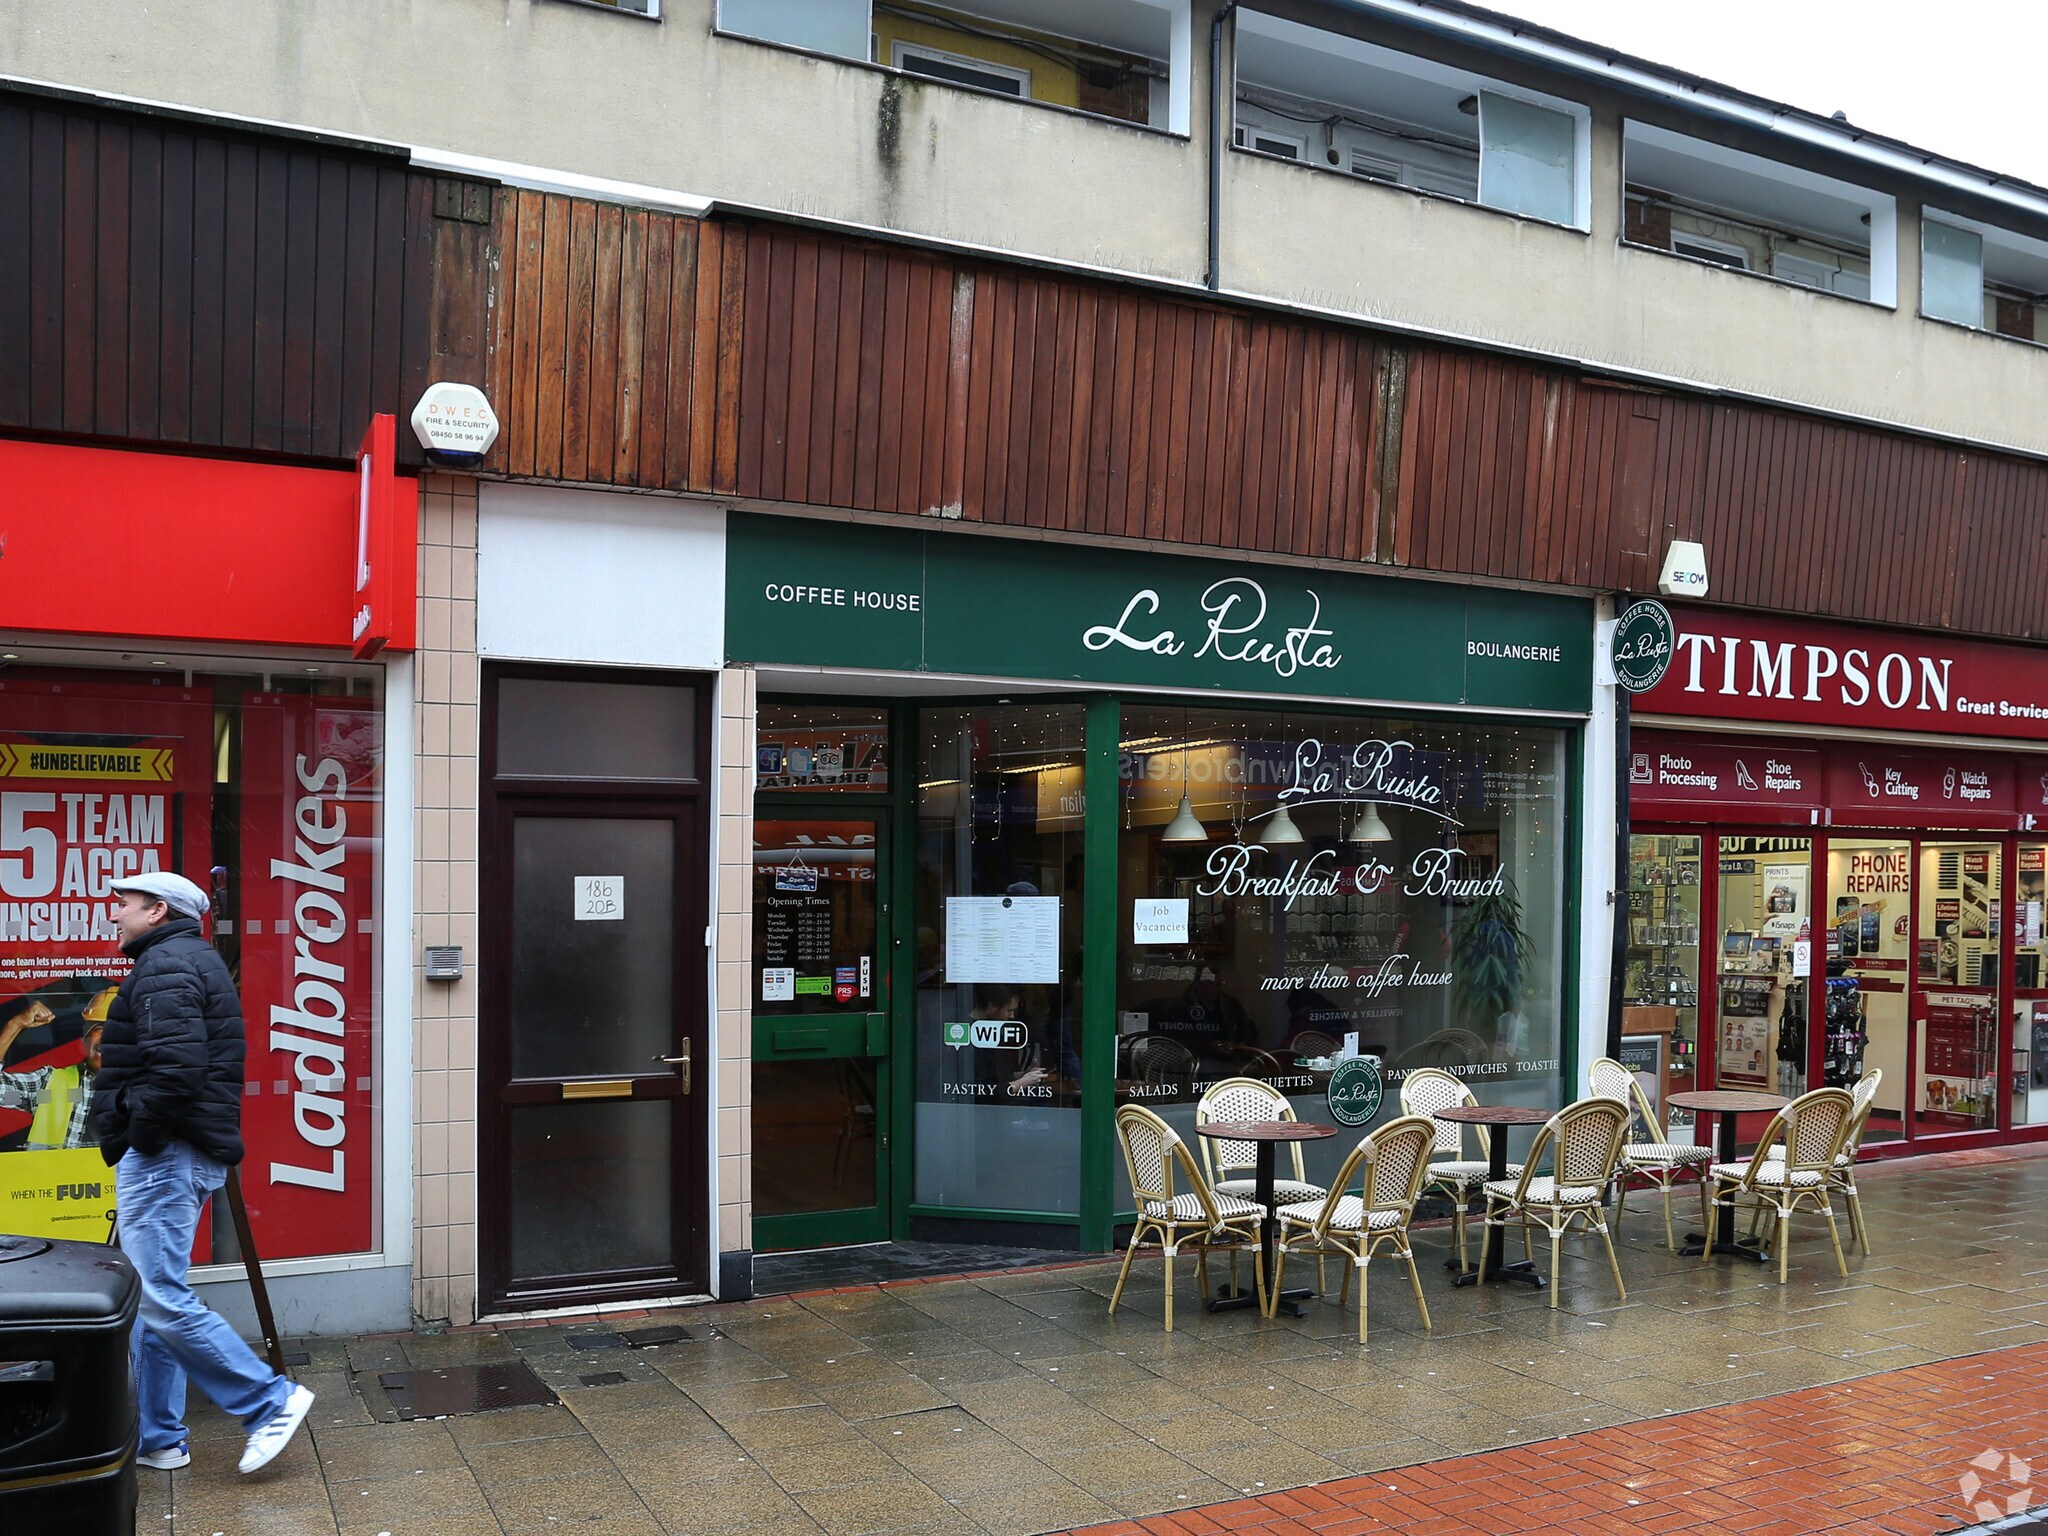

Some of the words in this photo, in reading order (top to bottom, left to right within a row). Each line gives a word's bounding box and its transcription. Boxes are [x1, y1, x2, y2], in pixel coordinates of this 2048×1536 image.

[425, 417, 443, 425] FIRE
[452, 420, 490, 429] SECURITY
[430, 430, 453, 438] 08450
[1672, 571, 1704, 585] SECOM
[765, 583, 845, 606] COFFEE
[853, 590, 920, 612] HOUSE
[1082, 588, 1185, 656] La
[1193, 576, 1342, 677] Rusta
[1618, 605, 1642, 636] COFFEE
[1644, 604, 1667, 629] HOUSE
[1467, 640, 1561, 662] BOULANGERIÉ
[1614, 642, 1636, 661] La
[1636, 633, 1669, 658] Rusta
[1618, 663, 1664, 688] BOULANGERIE
[1676, 632, 1953, 712] TIMPSON
[1956, 697, 1995, 716] Great
[30, 751, 142, 774] #UNBELIEVABLE
[1277, 738, 1333, 799] La
[1345, 739, 1443, 804] Rusta
[1659, 753, 1692, 771] Photo
[1765, 759, 1792, 774] Shoe
[1659, 770, 1718, 791] Processing
[1765, 775, 1801, 793] Repairs
[1885, 768, 1902, 784] Key
[1961, 772, 1988, 786] Watch
[1885, 782, 1919, 800] Cutting
[1960, 786, 1992, 802] Repairs
[1, 791, 57, 898] 5
[61, 793, 165, 844] TEAM
[1852, 854, 1906, 873] PHONE
[1196, 844, 1341, 912] Breakfast
[1355, 857, 1394, 894] &
[1403, 847, 1506, 897] Brunch
[1847, 874, 1909, 893] REPAIRS
[586, 900, 617, 915] 20B
[767, 897, 803, 907] Opening
[805, 897, 830, 905] Times
[1152, 906, 1170, 917] Job
[1136, 922, 1186, 932] Vacancies
[1775, 921, 1796, 929] iSnaps
[1, 958, 15, 966] one
[17, 957, 35, 966] team
[36, 956, 49, 966] lets
[51, 958, 65, 967] you
[65, 956, 85, 966] down
[86, 956, 94, 965] in
[95, 958, 111, 967] your
[111, 957, 127, 965] acca
[19, 969, 31, 979] get
[32, 970, 49, 979] your
[50, 969, 74, 979] money
[75, 968, 92, 977] back
[93, 969, 101, 977] as
[102, 969, 107, 977] a
[108, 968, 122, 976] free
[269, 752, 347, 1193] Ladbrokes
[1261, 976, 1303, 991] more
[1309, 963, 1350, 990] than
[1356, 954, 1409, 998] coffee
[1408, 961, 1453, 986] house
[1335, 1062, 1356, 1083] COFFEE
[1359, 1062, 1376, 1080] HOUSE
[943, 1082, 997, 1096] PASTRY
[1007, 1085, 1053, 1098] CAKES
[1129, 1083, 1178, 1098] SALADS
[1331, 1088, 1350, 1101] La
[1350, 1082, 1379, 1101] Rusta
[11, 1190, 35, 1200] WHEN
[38, 1189, 53, 1198] THE
[56, 1183, 101, 1201] FUN
